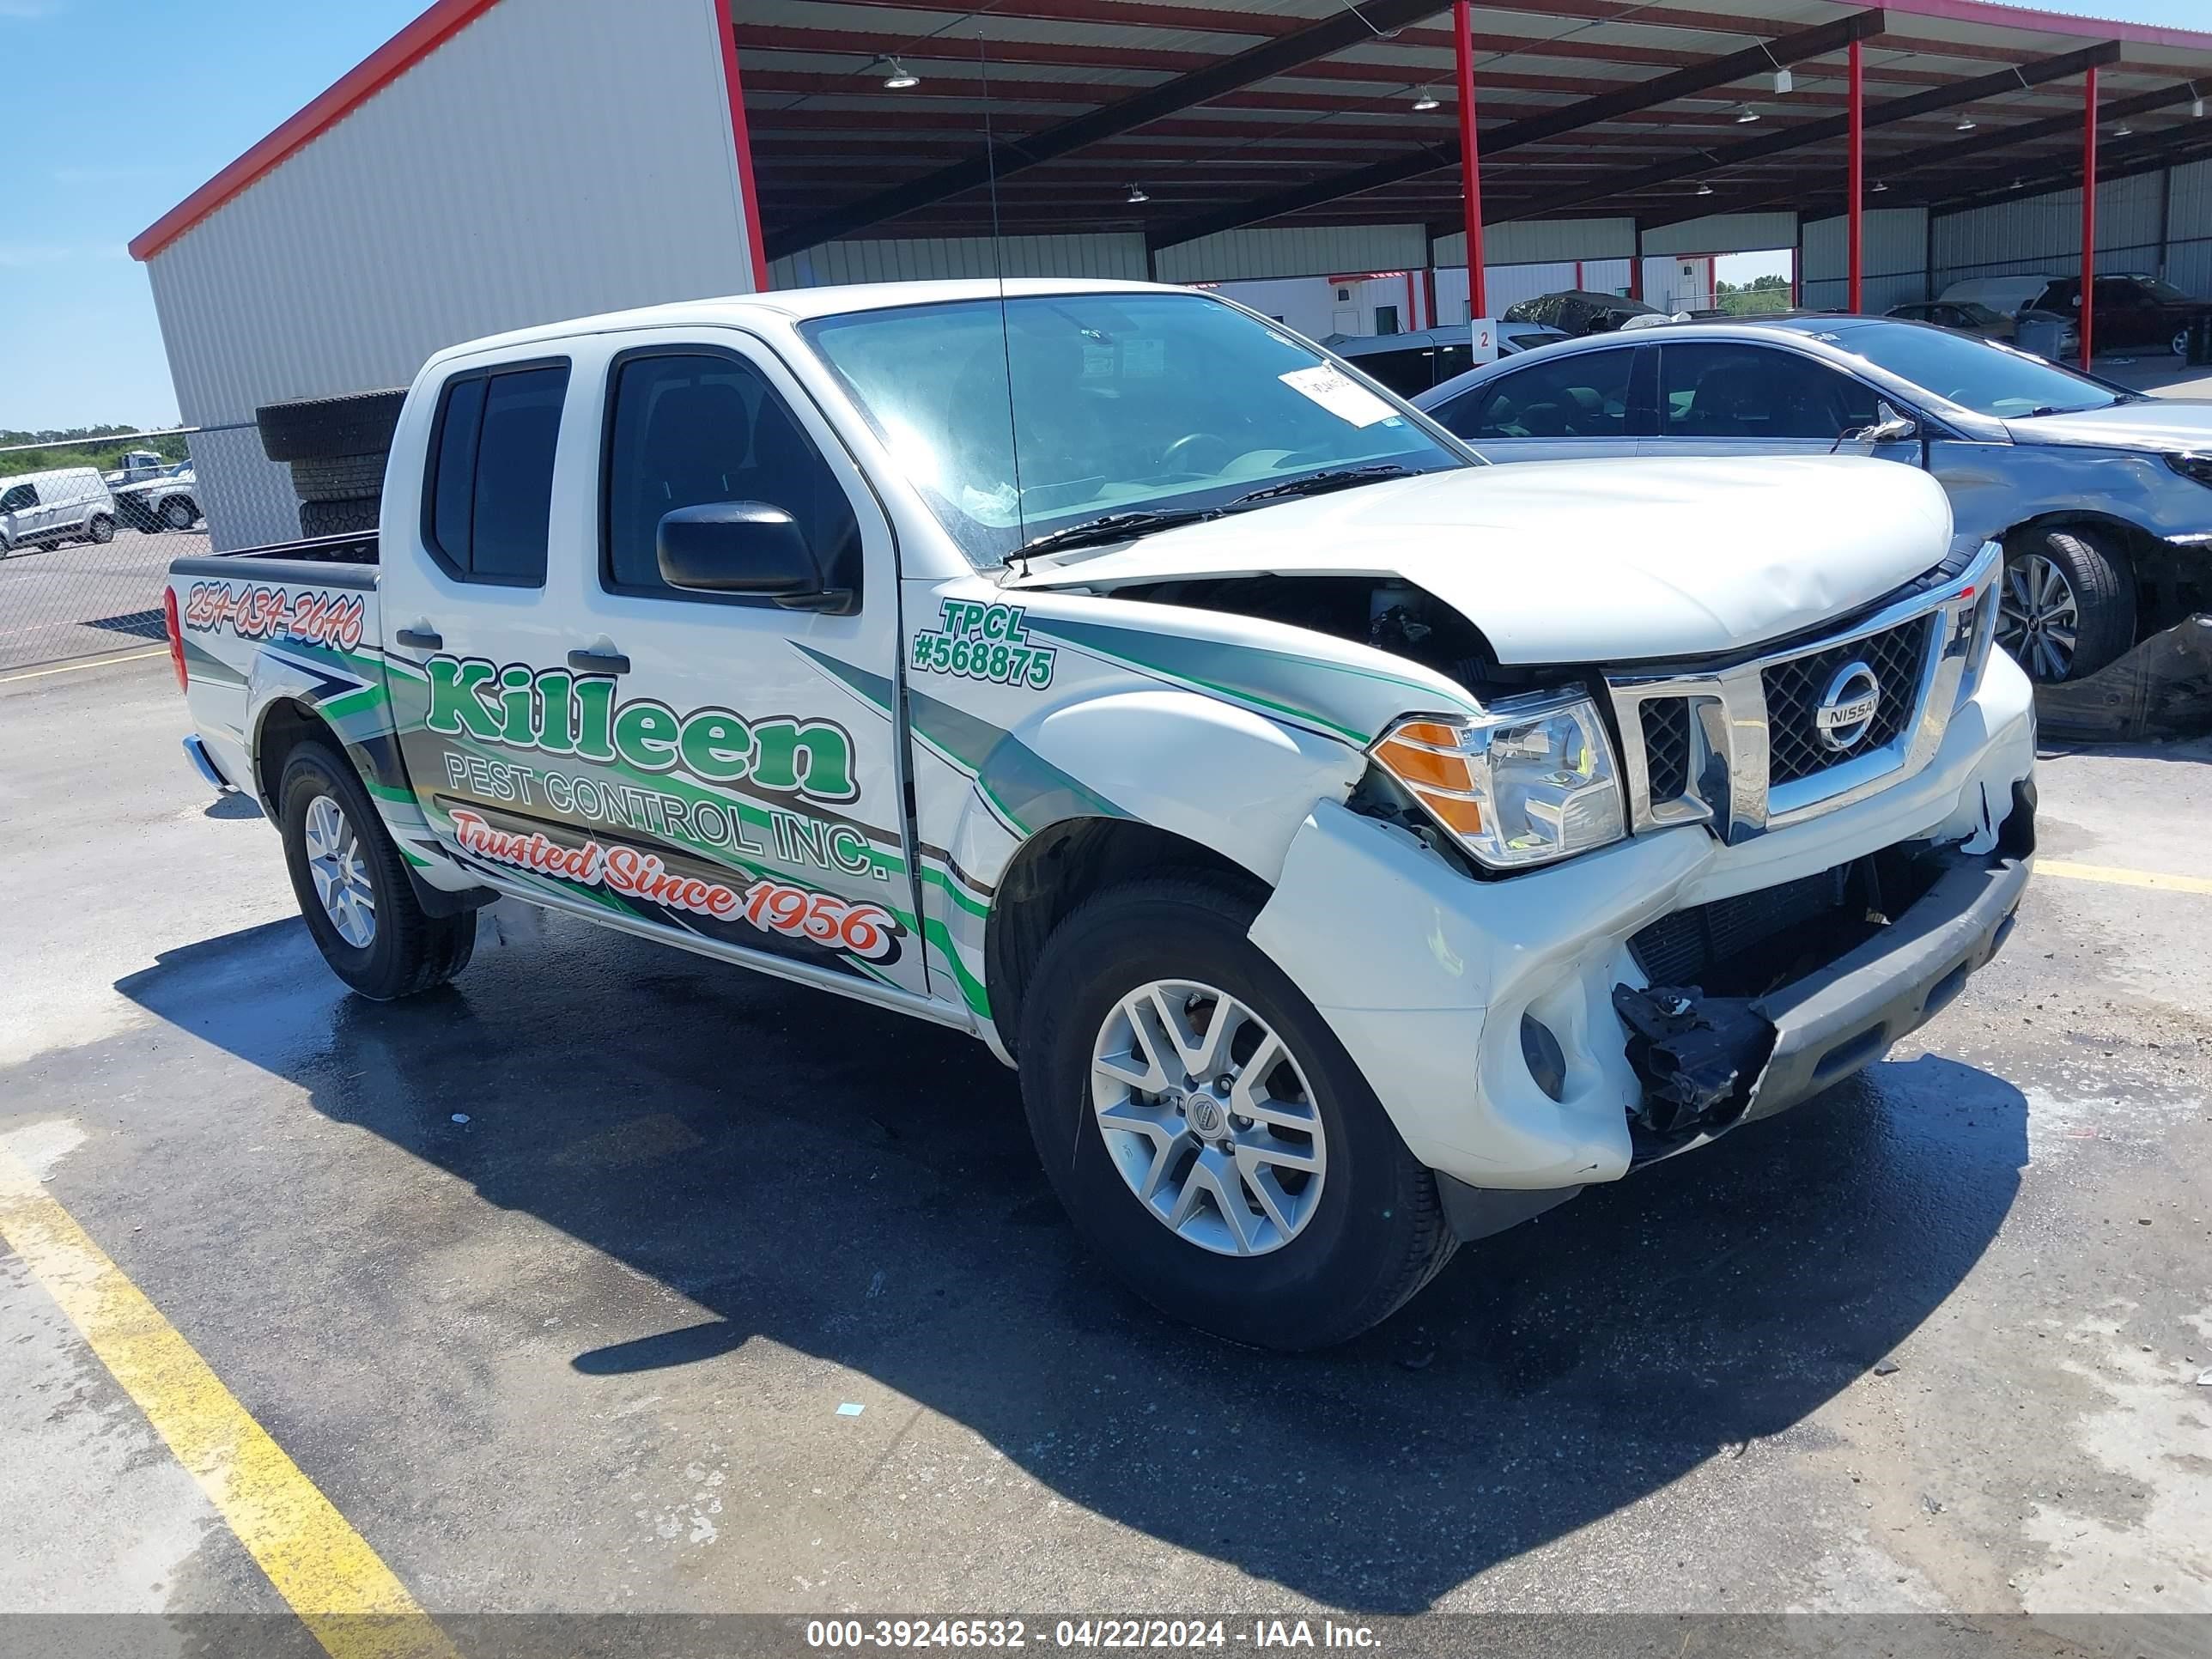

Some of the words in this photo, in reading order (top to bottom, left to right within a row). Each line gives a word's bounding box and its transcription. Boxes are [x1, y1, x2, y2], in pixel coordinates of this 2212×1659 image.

[1480, 331, 1489, 348] 2
[186, 584, 363, 649] 254-634-2646
[943, 602, 1025, 642] TPCL
[914, 634, 1052, 684] #568875
[425, 656, 858, 802] Killeen
[1830, 698, 1879, 724] NISSAN
[444, 751, 534, 805] PEST
[543, 767, 763, 857] CONTROL
[770, 810, 890, 881] INC.
[450, 810, 599, 881] Trusted
[603, 847, 738, 916] Since
[744, 880, 884, 954] 1956
